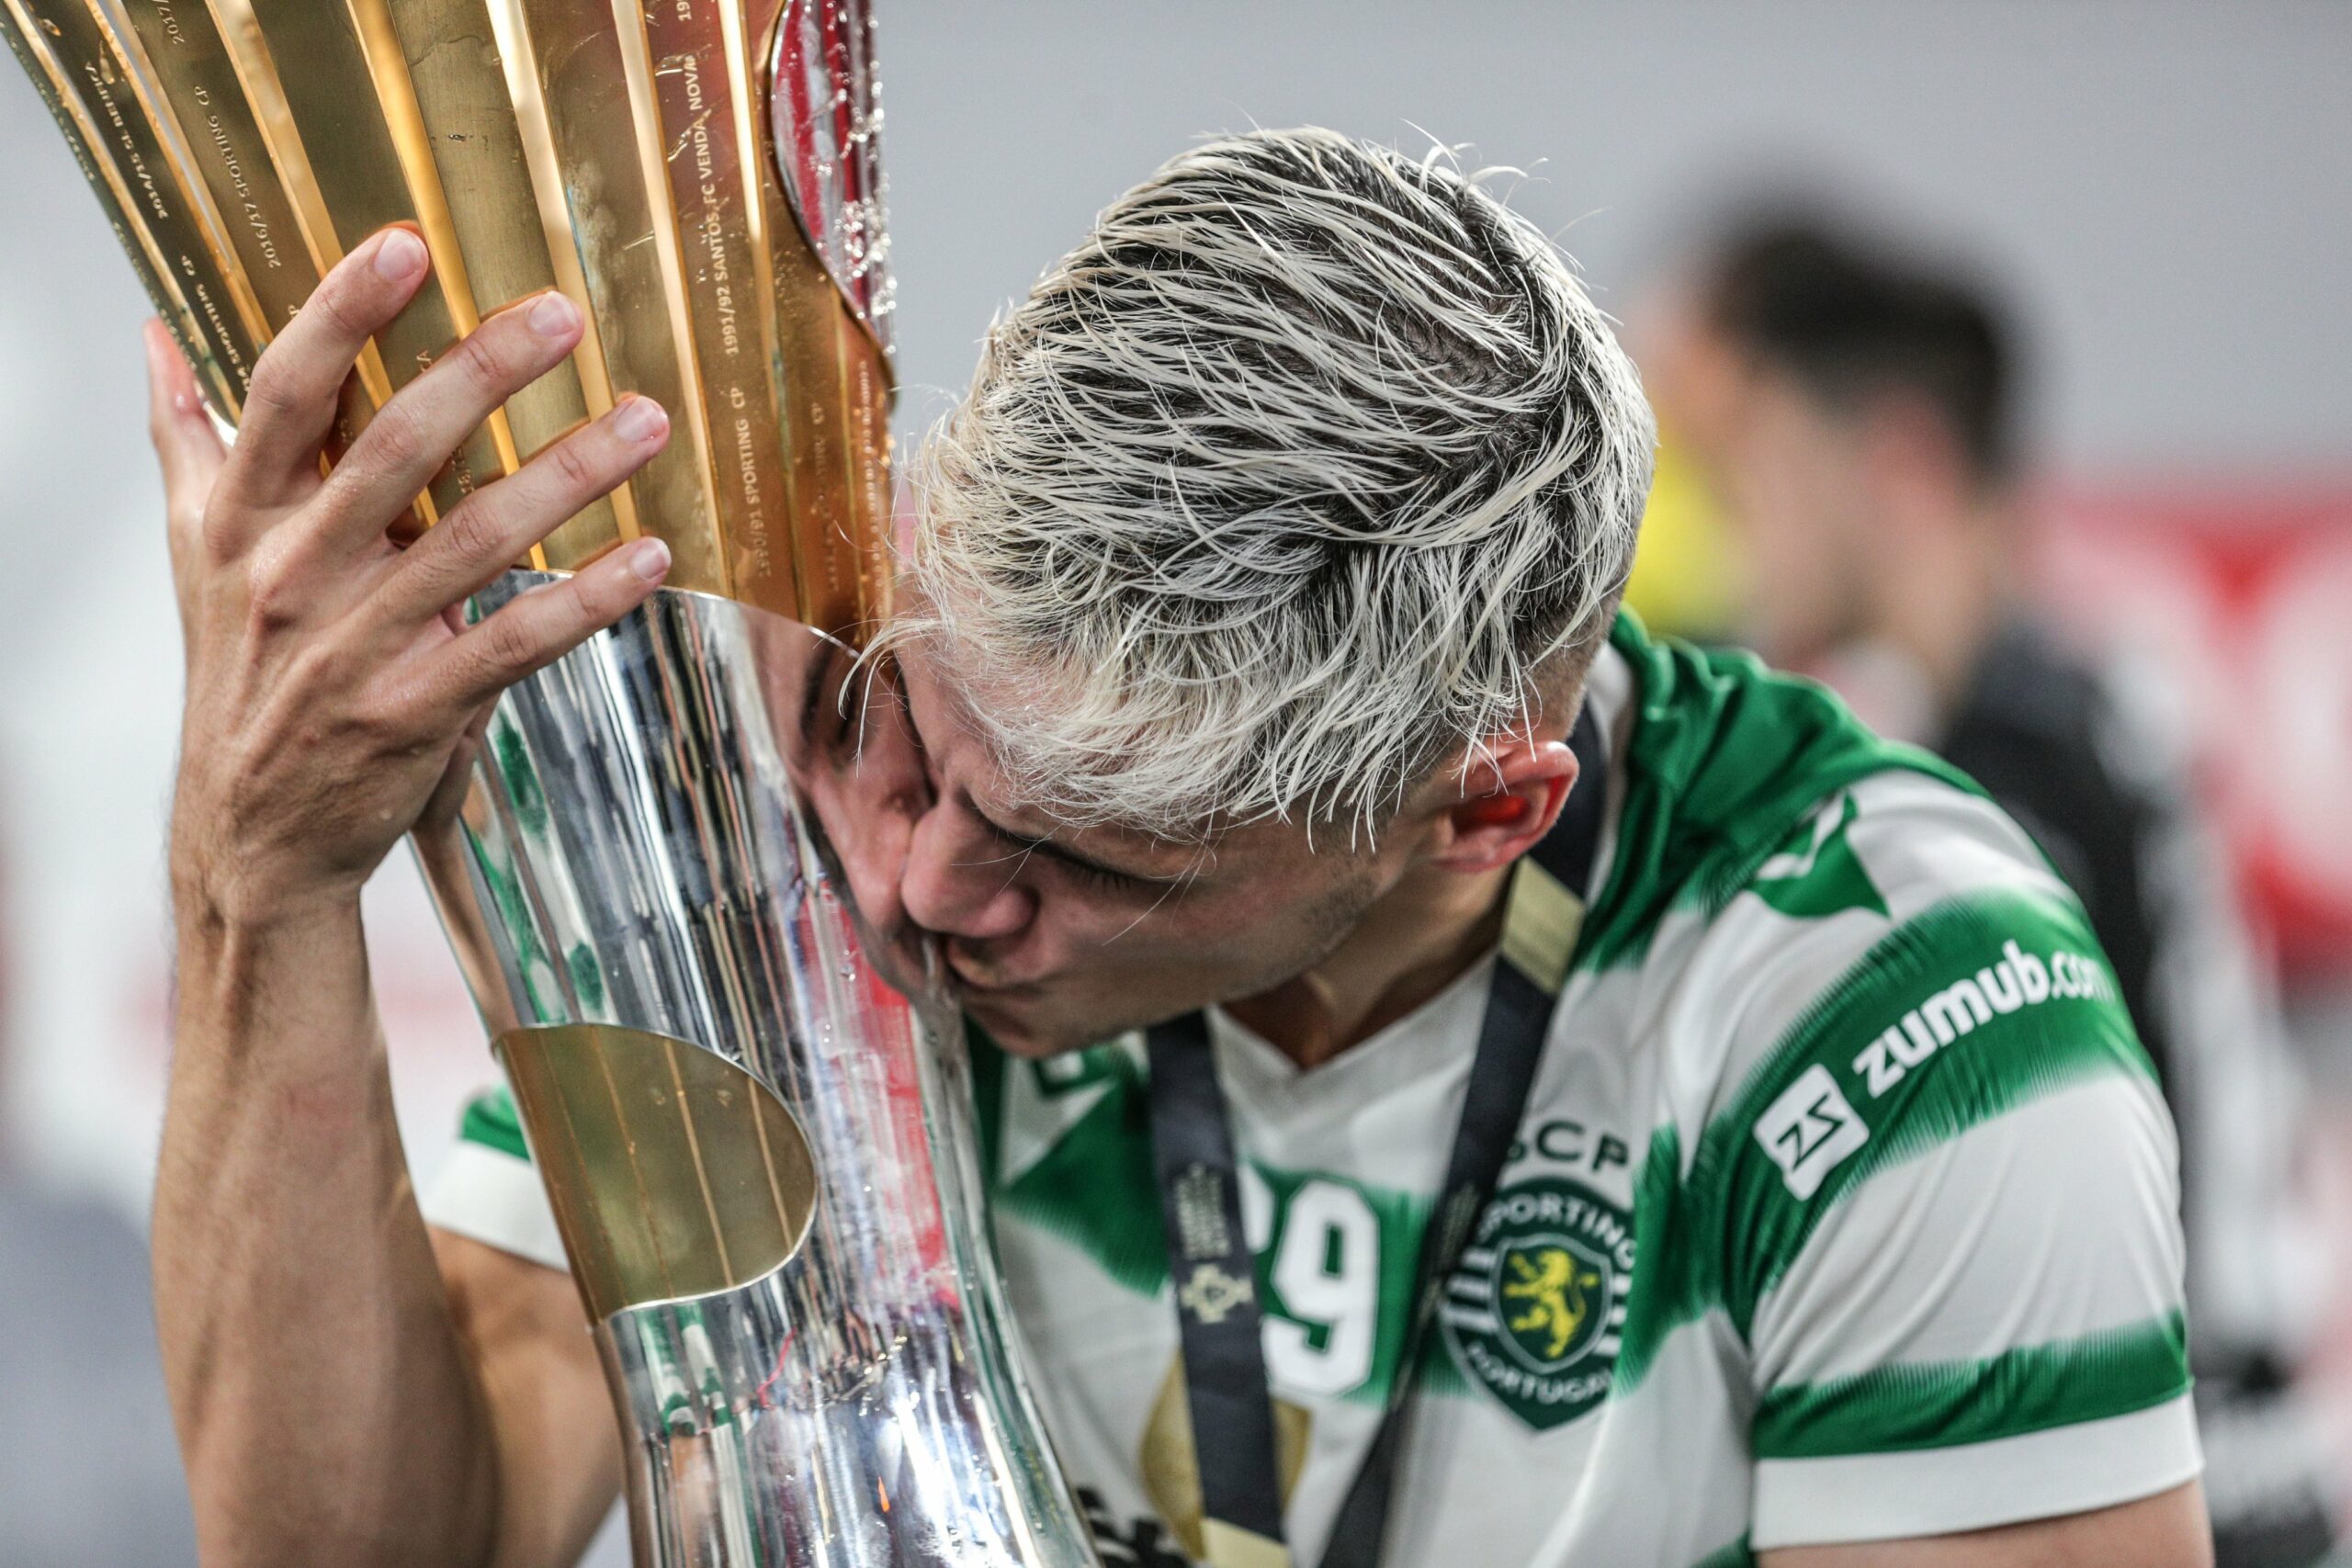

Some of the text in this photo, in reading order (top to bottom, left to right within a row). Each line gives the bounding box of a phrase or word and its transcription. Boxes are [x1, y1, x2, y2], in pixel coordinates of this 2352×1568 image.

[194, 85, 282, 268] 2016/17 SPORTING CP
[691, 119, 713, 180] VENDA
[130, 152, 169, 220] 2014/15
[701, 184, 718, 205] FC
[181, 254, 196, 276] CP
[196, 283, 241, 365] SPORTING
[717, 286, 740, 355] 1991/92
[729, 387, 745, 410] CP
[735, 418, 760, 505] SPORTING
